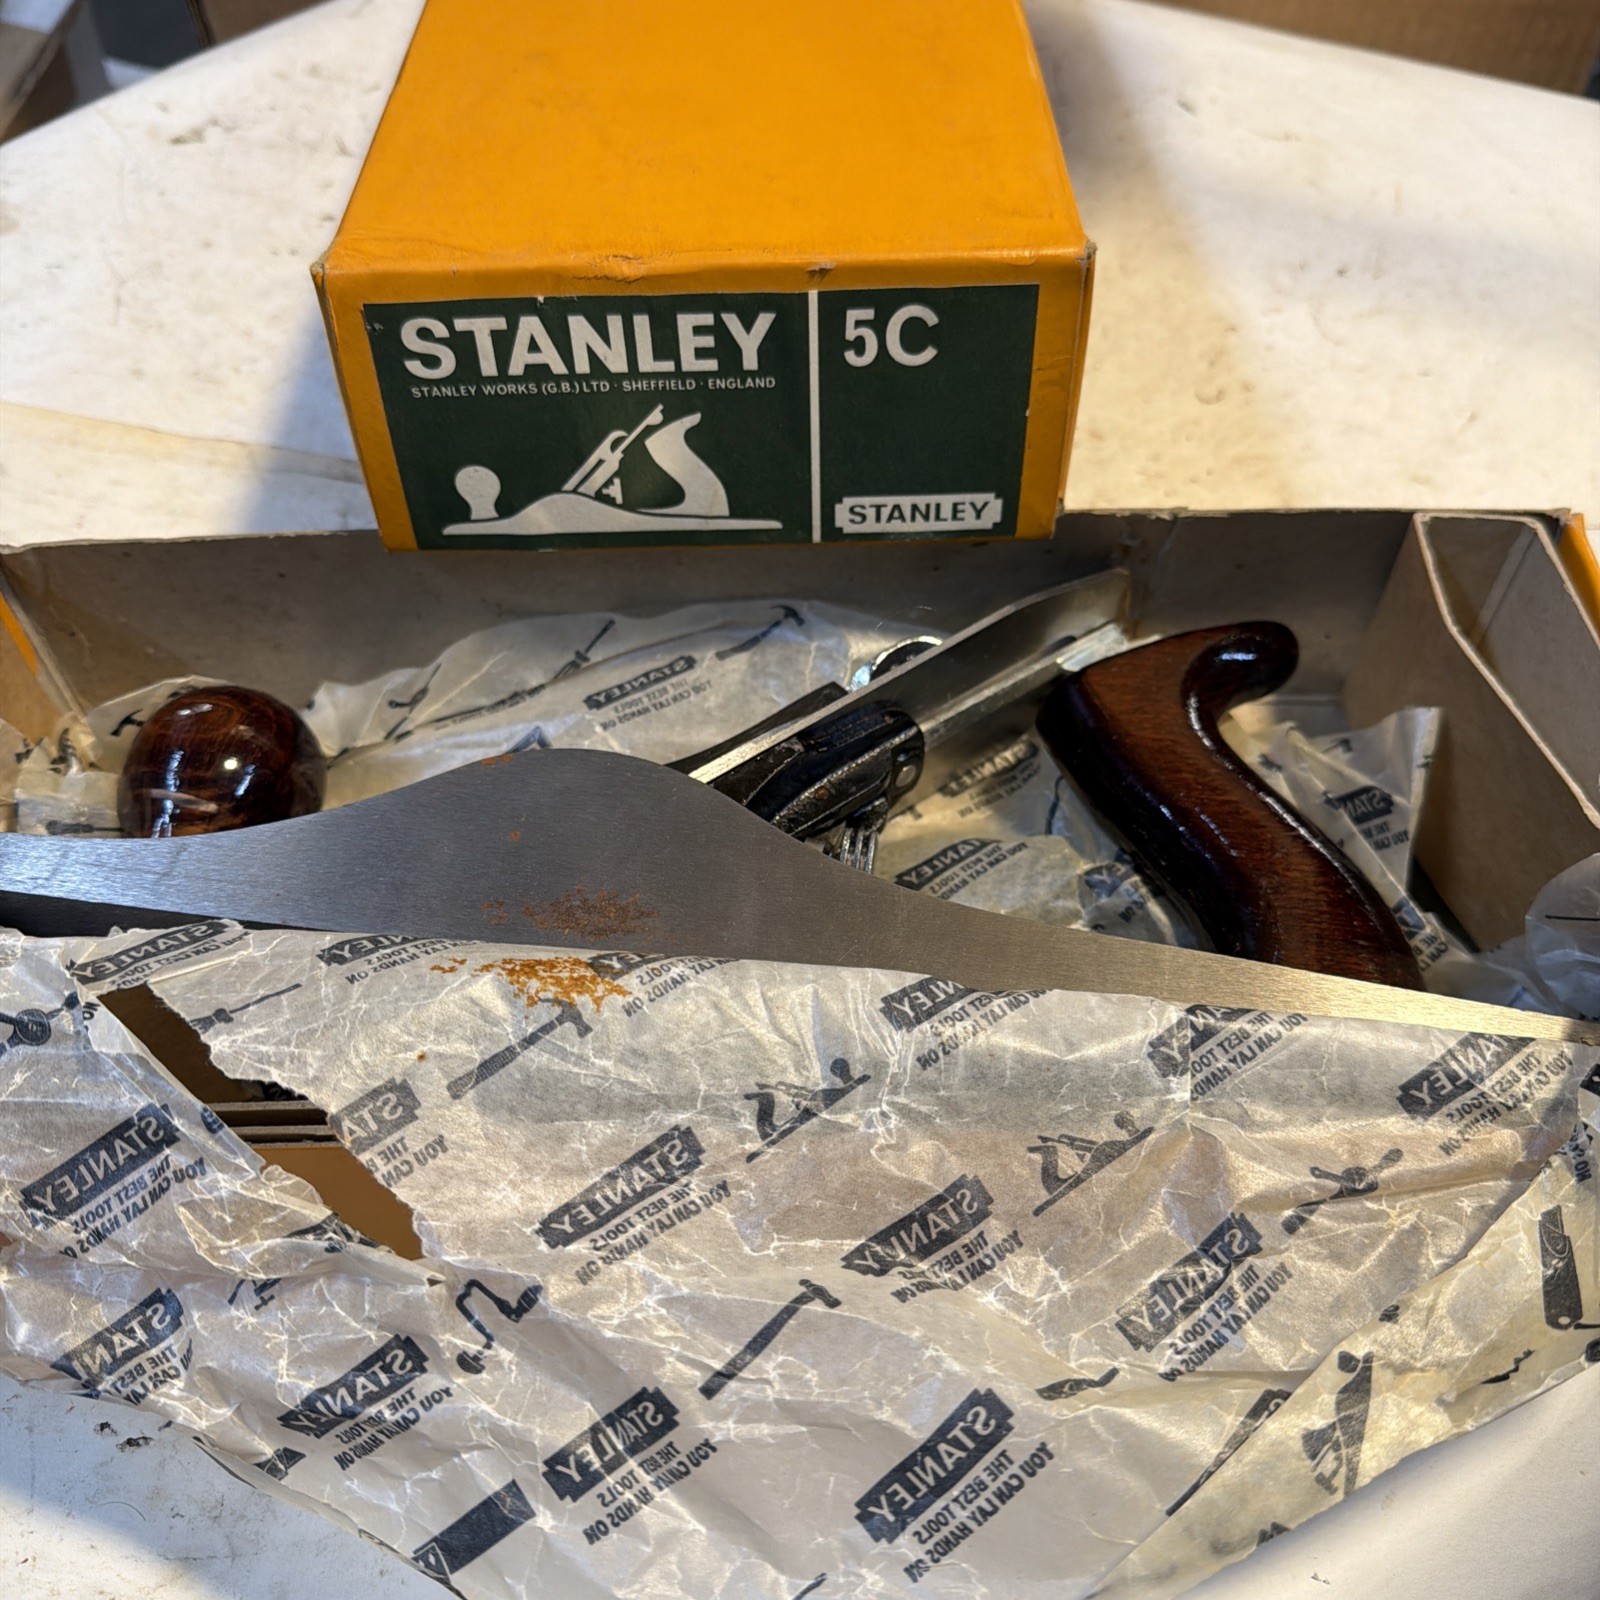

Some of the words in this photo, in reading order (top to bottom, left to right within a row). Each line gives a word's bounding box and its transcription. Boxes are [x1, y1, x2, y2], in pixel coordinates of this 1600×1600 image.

[400, 312, 777, 380] STANLEY
[843, 304, 940, 367] 5C
[411, 384, 477, 399] STANLEY
[480, 382, 538, 397] WORKS
[541, 380, 580, 396] (G.B.)
[582, 379, 611, 394] LTD
[622, 378, 696, 392] SHEFFIELD
[708, 376, 776, 390] ENGLAND
[848, 500, 990, 525] STANLEY
